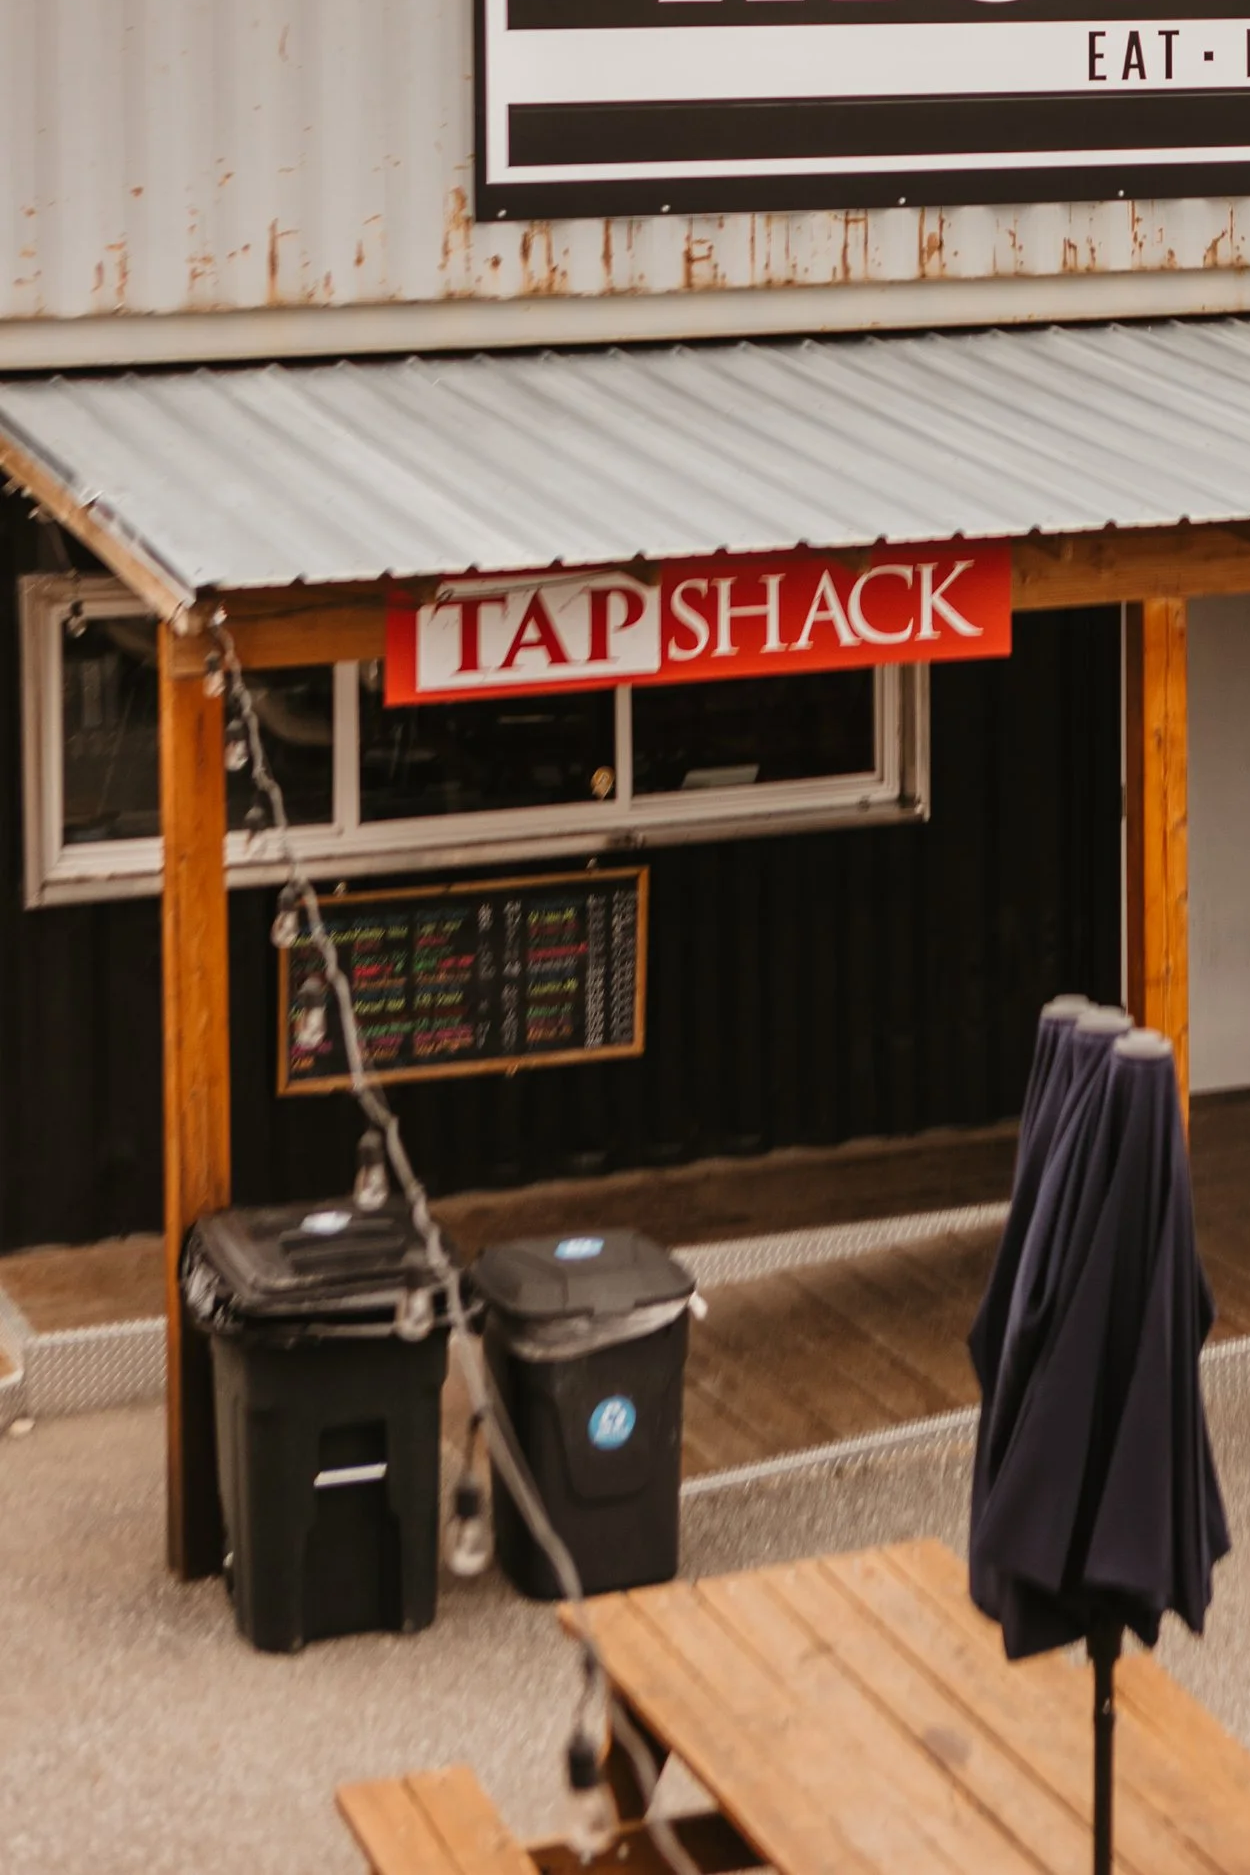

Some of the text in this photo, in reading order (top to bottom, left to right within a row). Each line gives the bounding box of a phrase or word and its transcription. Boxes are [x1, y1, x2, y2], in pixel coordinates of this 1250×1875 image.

[1087, 29, 1181, 82] EAT
[434, 559, 983, 674] TAP SHACK
